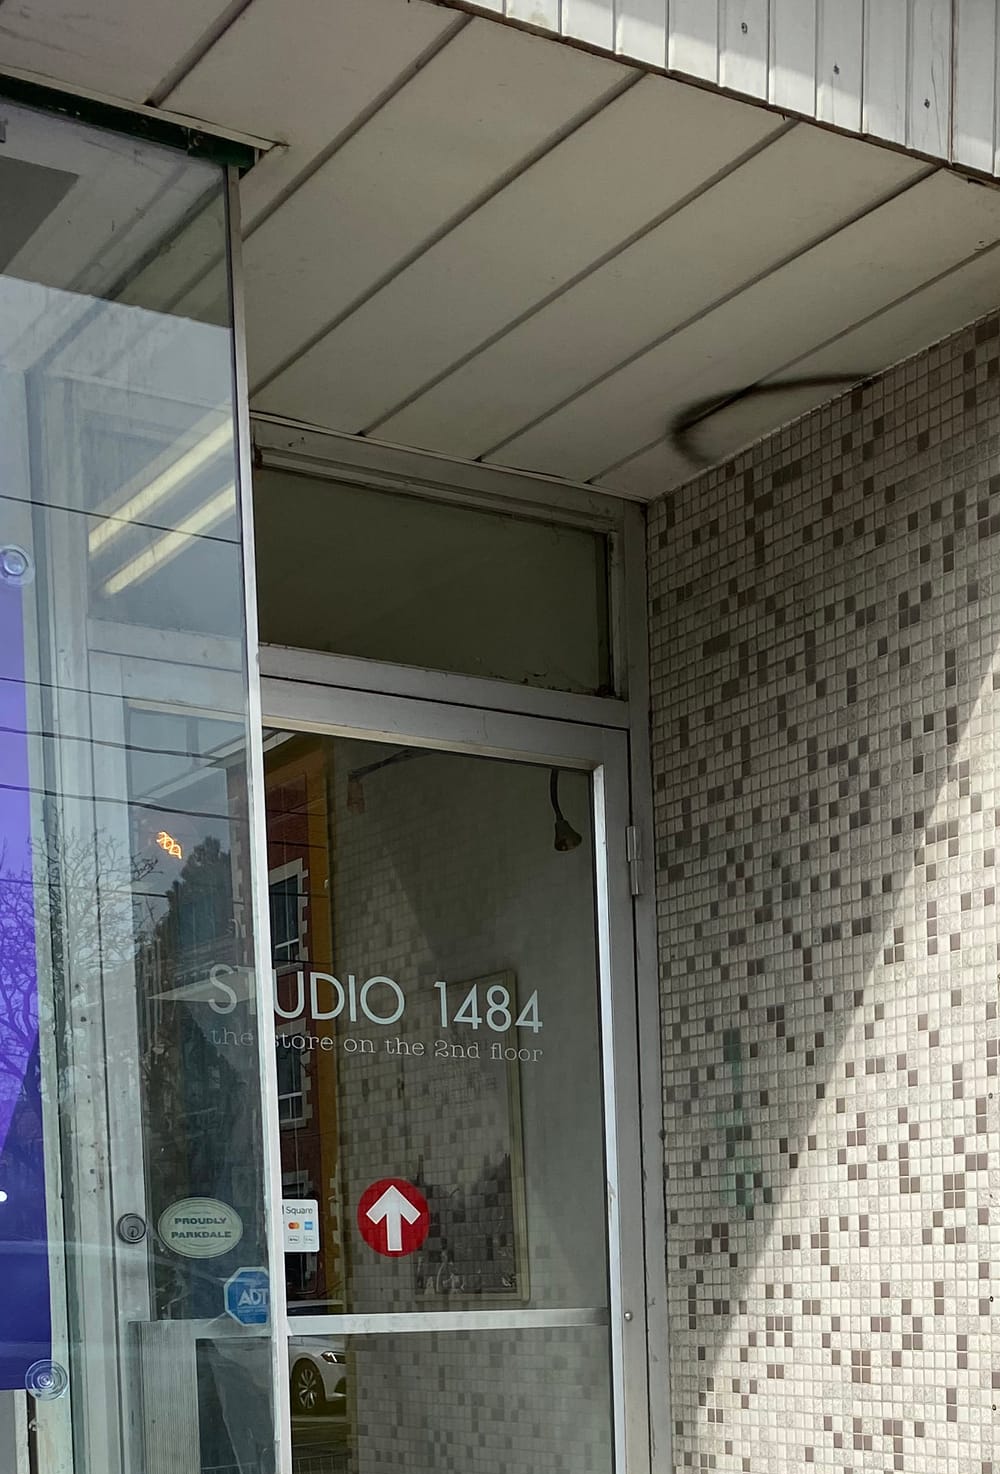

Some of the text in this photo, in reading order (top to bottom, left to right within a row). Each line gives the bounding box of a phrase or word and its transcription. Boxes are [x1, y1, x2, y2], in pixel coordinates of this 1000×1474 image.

[208, 964, 544, 1034] STUDIO 1484
[211, 1027, 254, 1047] the
[343, 1037, 377, 1054] on
[384, 1037, 425, 1056] the
[434, 1040, 480, 1059] 2nd
[490, 1042, 543, 1062] floor
[285, 1206, 314, 1216] Square
[174, 1217, 227, 1225] PROUDLY
[171, 1231, 232, 1239] PARKDALE
[238, 1288, 269, 1306] ADT
